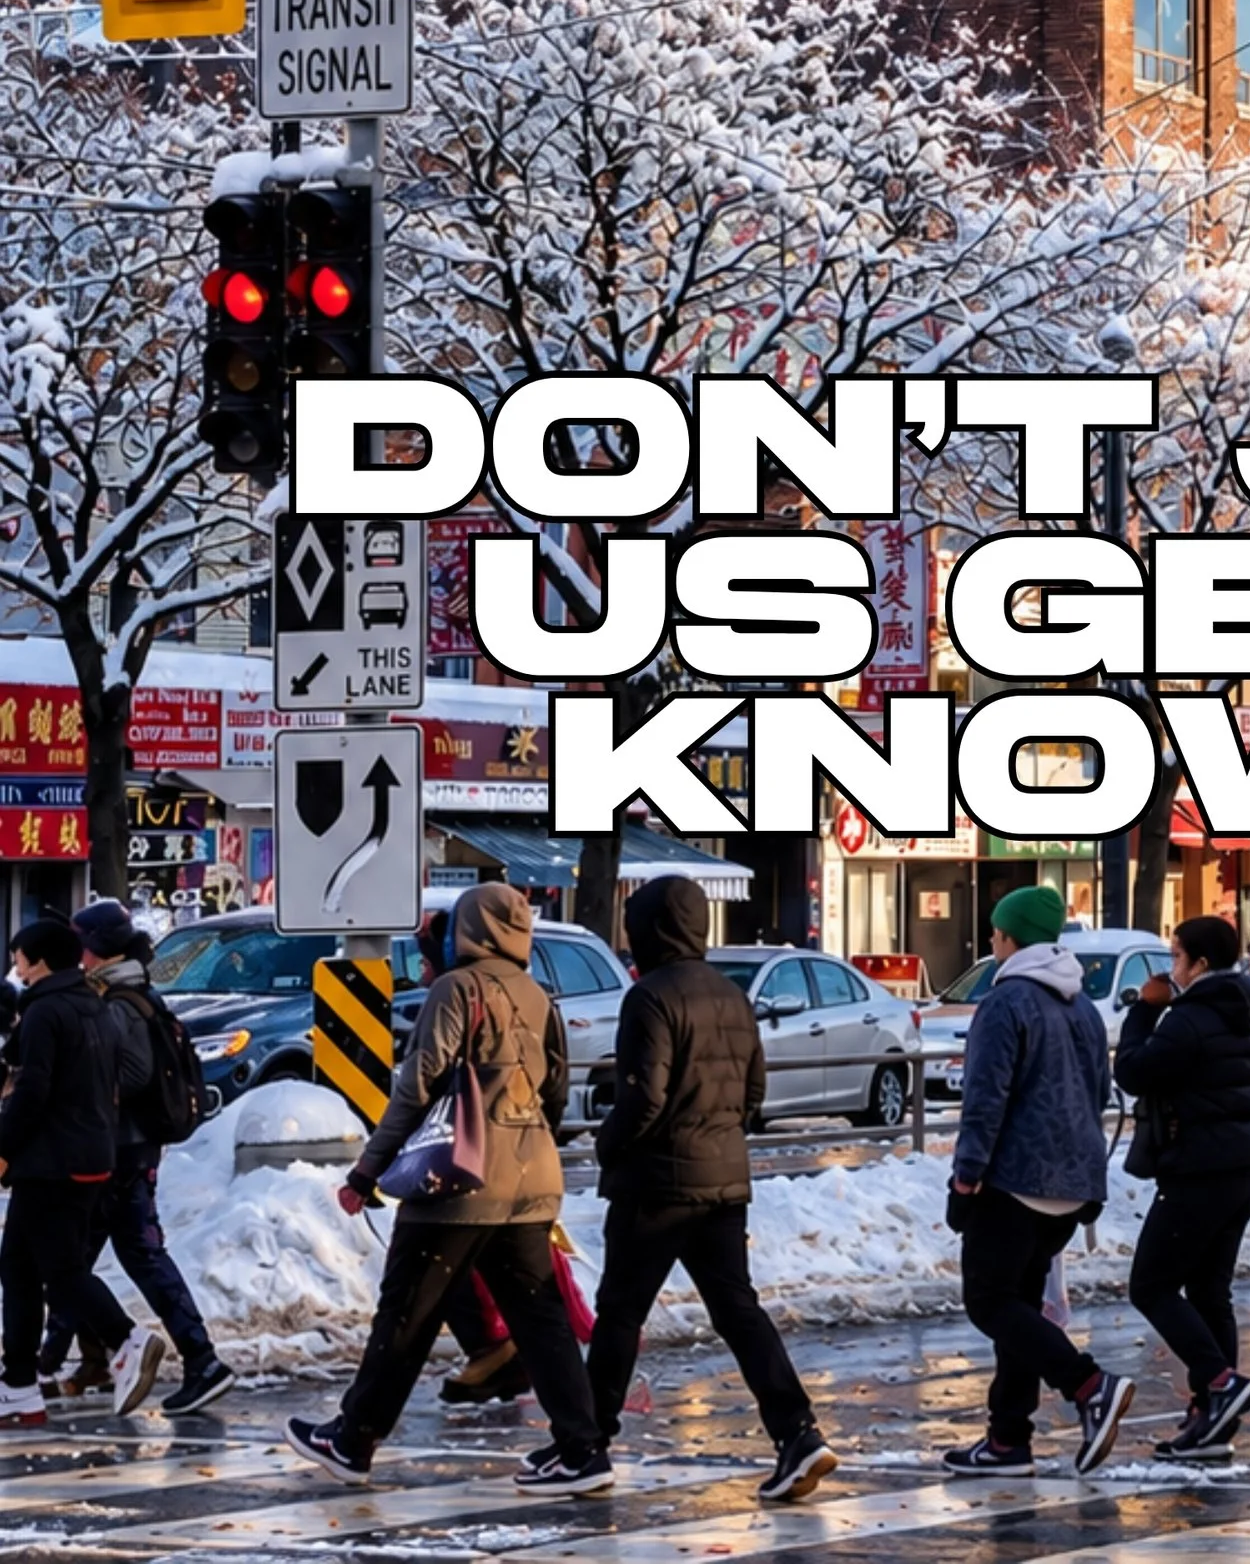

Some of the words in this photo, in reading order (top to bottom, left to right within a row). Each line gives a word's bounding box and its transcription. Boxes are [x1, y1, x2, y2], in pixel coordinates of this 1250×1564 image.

[277, 43, 394, 97] SIGNAL
[357, 646, 412, 669] THIS
[345, 674, 412, 698] LANE
